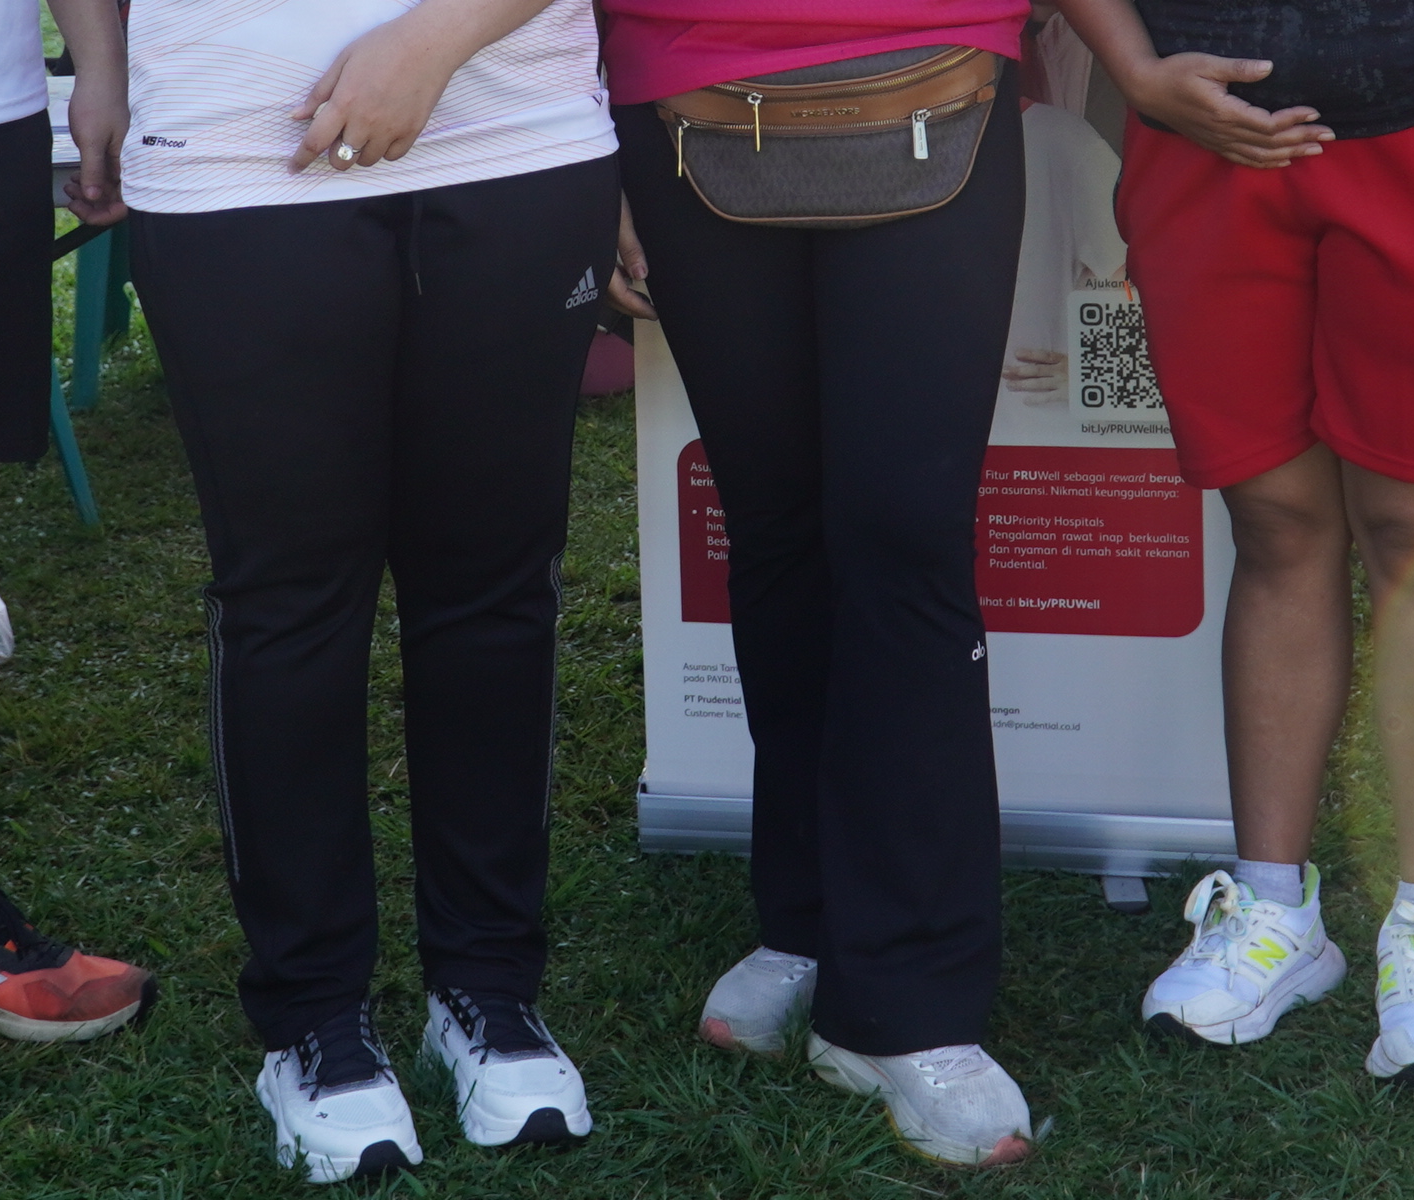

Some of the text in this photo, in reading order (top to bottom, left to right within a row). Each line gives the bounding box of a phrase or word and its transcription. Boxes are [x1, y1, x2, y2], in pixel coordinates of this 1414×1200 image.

[1085, 278, 1125, 290] Ajukan
[565, 288, 599, 310] adidas
[985, 470, 1185, 486] Fitur PRUWell sebagai reward berup
[1001, 485, 1049, 497] asuransi.
[1050, 486, 1093, 497] Nikmati
[1094, 486, 1180, 501] keunggulannya:
[988, 514, 1105, 529] PRUPriority Hospitals
[988, 529, 1191, 545] Pengalaman rawat inap berkualitas
[988, 543, 1191, 559] dan nyaman di rumah sakit rekanan
[989, 558, 1049, 570] Prudential.
[1005, 596, 1017, 607] di
[1018, 597, 1101, 611] bit.ly/PRUWell
[682, 662, 719, 672] Asuransi
[683, 674, 705, 684] pada
[683, 694, 742, 705] PT Prudential
[684, 708, 725, 719] Customer
